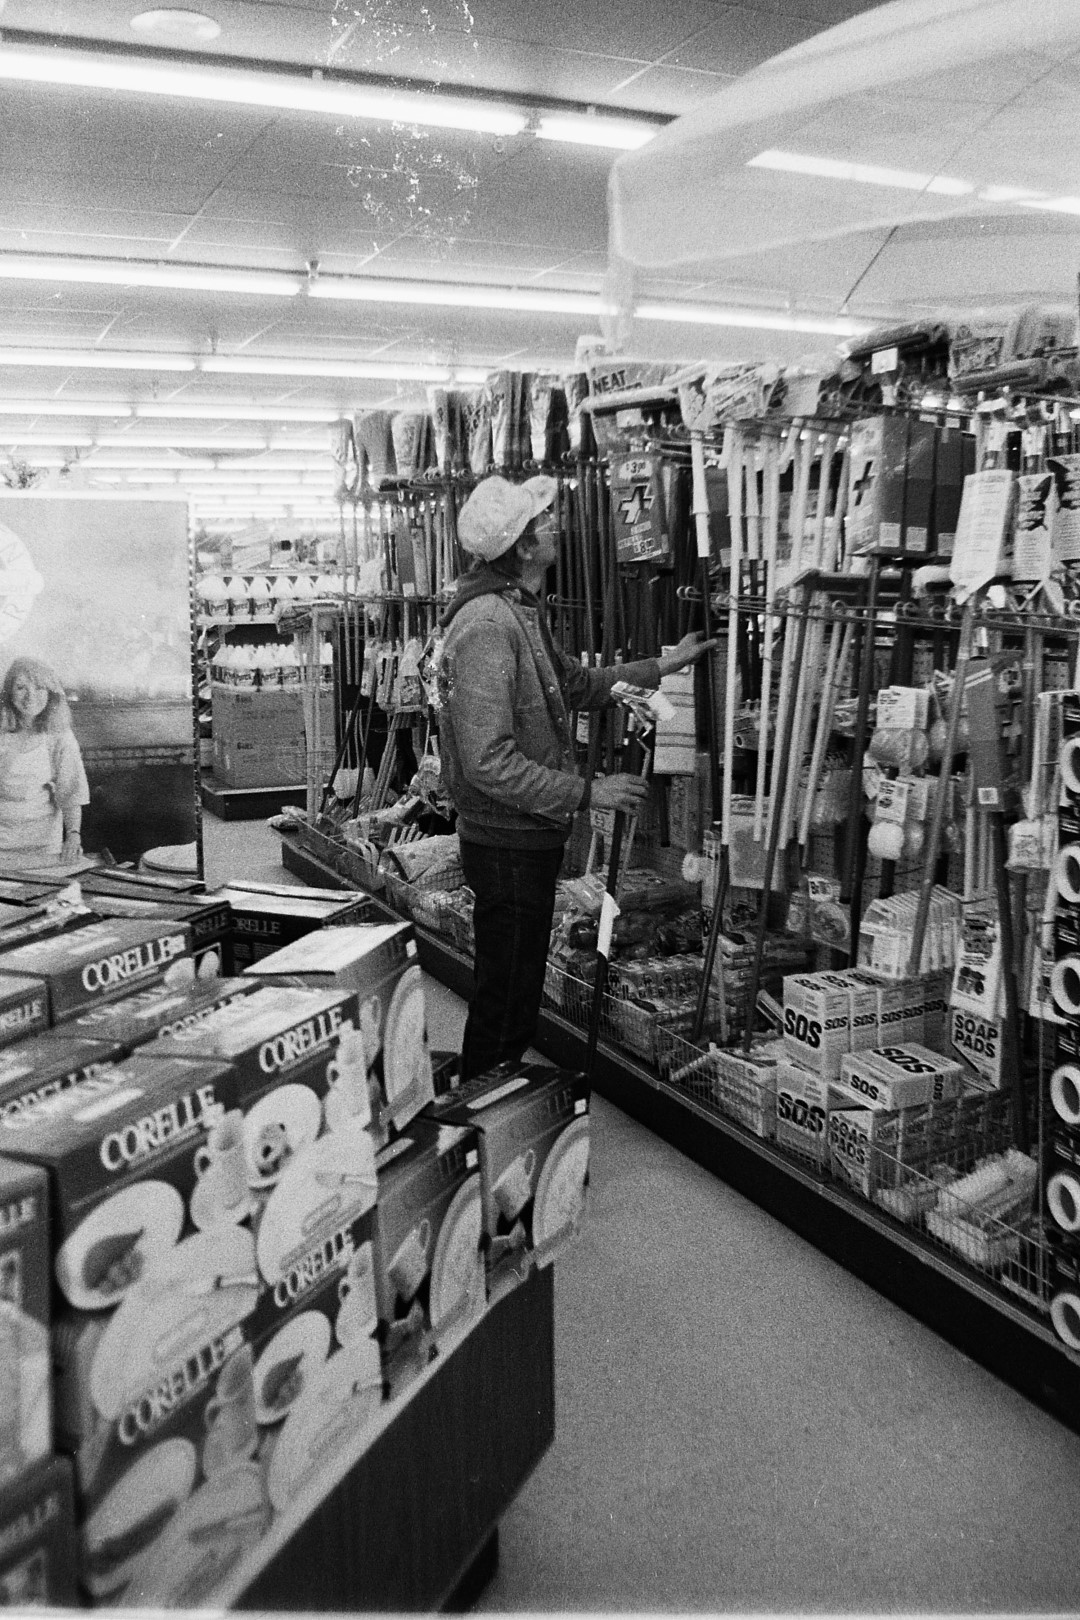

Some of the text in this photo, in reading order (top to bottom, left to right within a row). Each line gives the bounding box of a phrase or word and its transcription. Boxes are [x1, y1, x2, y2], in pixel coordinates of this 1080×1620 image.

[592, 369, 626, 397] NEAT
[82, 936, 174, 992] CORELLE
[824, 1016, 849, 1031] SOS
[852, 1013, 877, 1028] SOS
[880, 1010, 902, 1024] SOS
[900, 1005, 924, 1019] SOS
[259, 1006, 342, 1073] CORELLE
[784, 1007, 823, 1049] SOS
[955, 1014, 998, 1041] SOAP
[955, 1029, 996, 1059] PADS
[872, 1047, 937, 1074] SOS
[850, 1074, 880, 1101] SOS
[778, 1091, 827, 1133] SOS
[100, 1085, 215, 1171] CORELLE
[830, 1115, 869, 1146] SOAP
[830, 1131, 866, 1165] PADS
[274, 1226, 353, 1308] CORELLE
[118, 1335, 226, 1445] CORELLE
